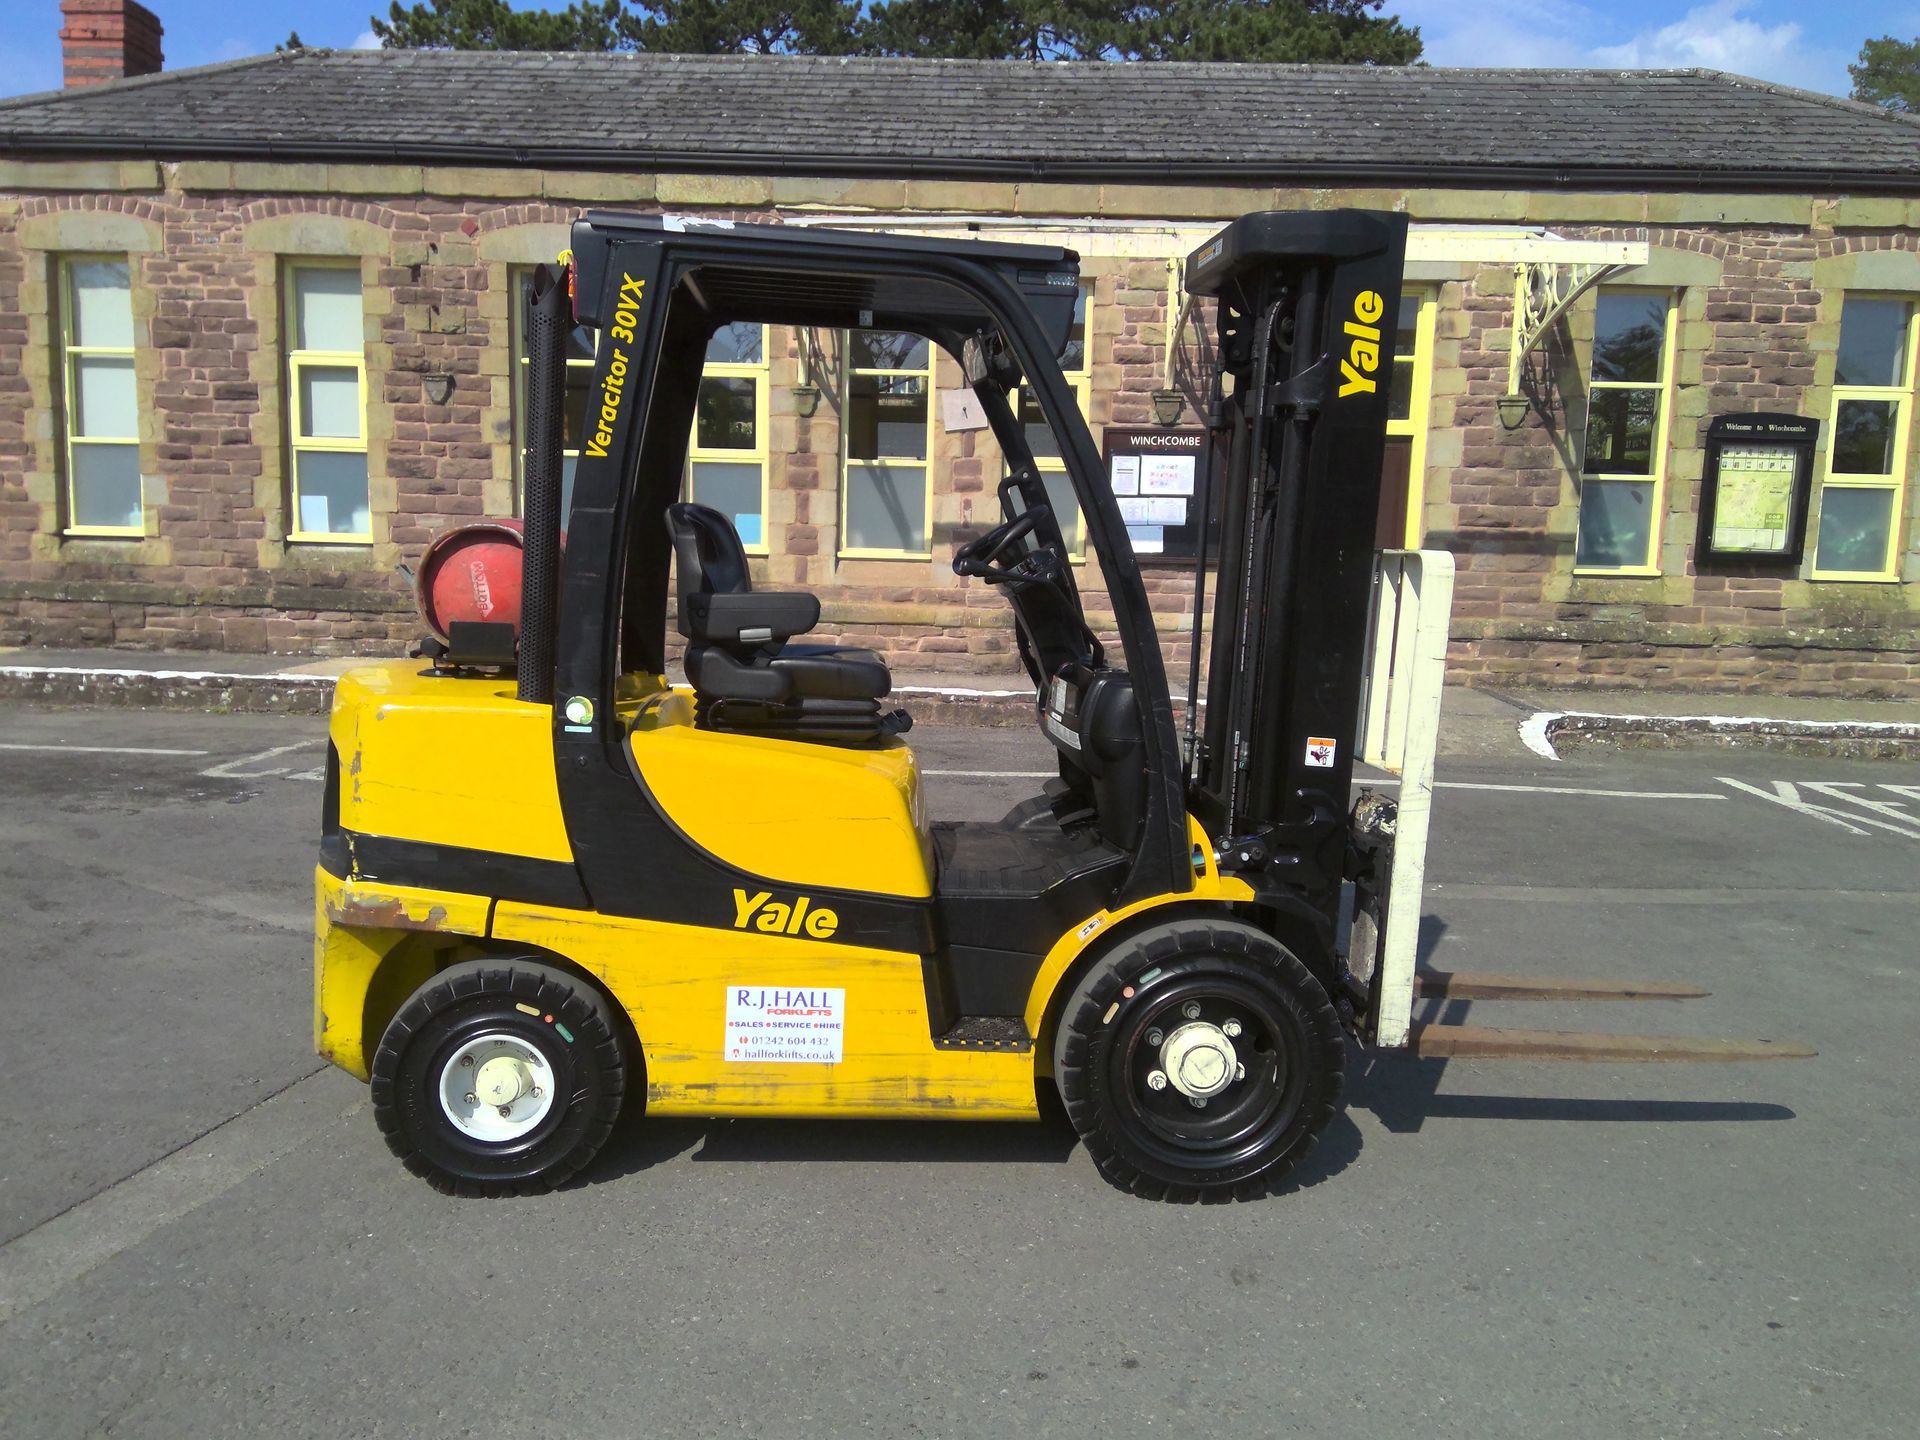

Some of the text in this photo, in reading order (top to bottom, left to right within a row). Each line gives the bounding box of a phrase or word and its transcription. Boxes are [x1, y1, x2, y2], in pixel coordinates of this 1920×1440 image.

[1338, 290, 1384, 398] Yale
[585, 271, 646, 457] Veracitor 30VX
[1725, 423, 1752, 431] Welcome
[1130, 435, 1201, 446] WINCHCOMBE
[733, 888, 839, 939] Yale
[767, 1008, 832, 1017] FORKLIFTS
[751, 1036, 829, 1047] 01242 604 432
[744, 1048, 835, 1061] hallforklifts.co.uk
